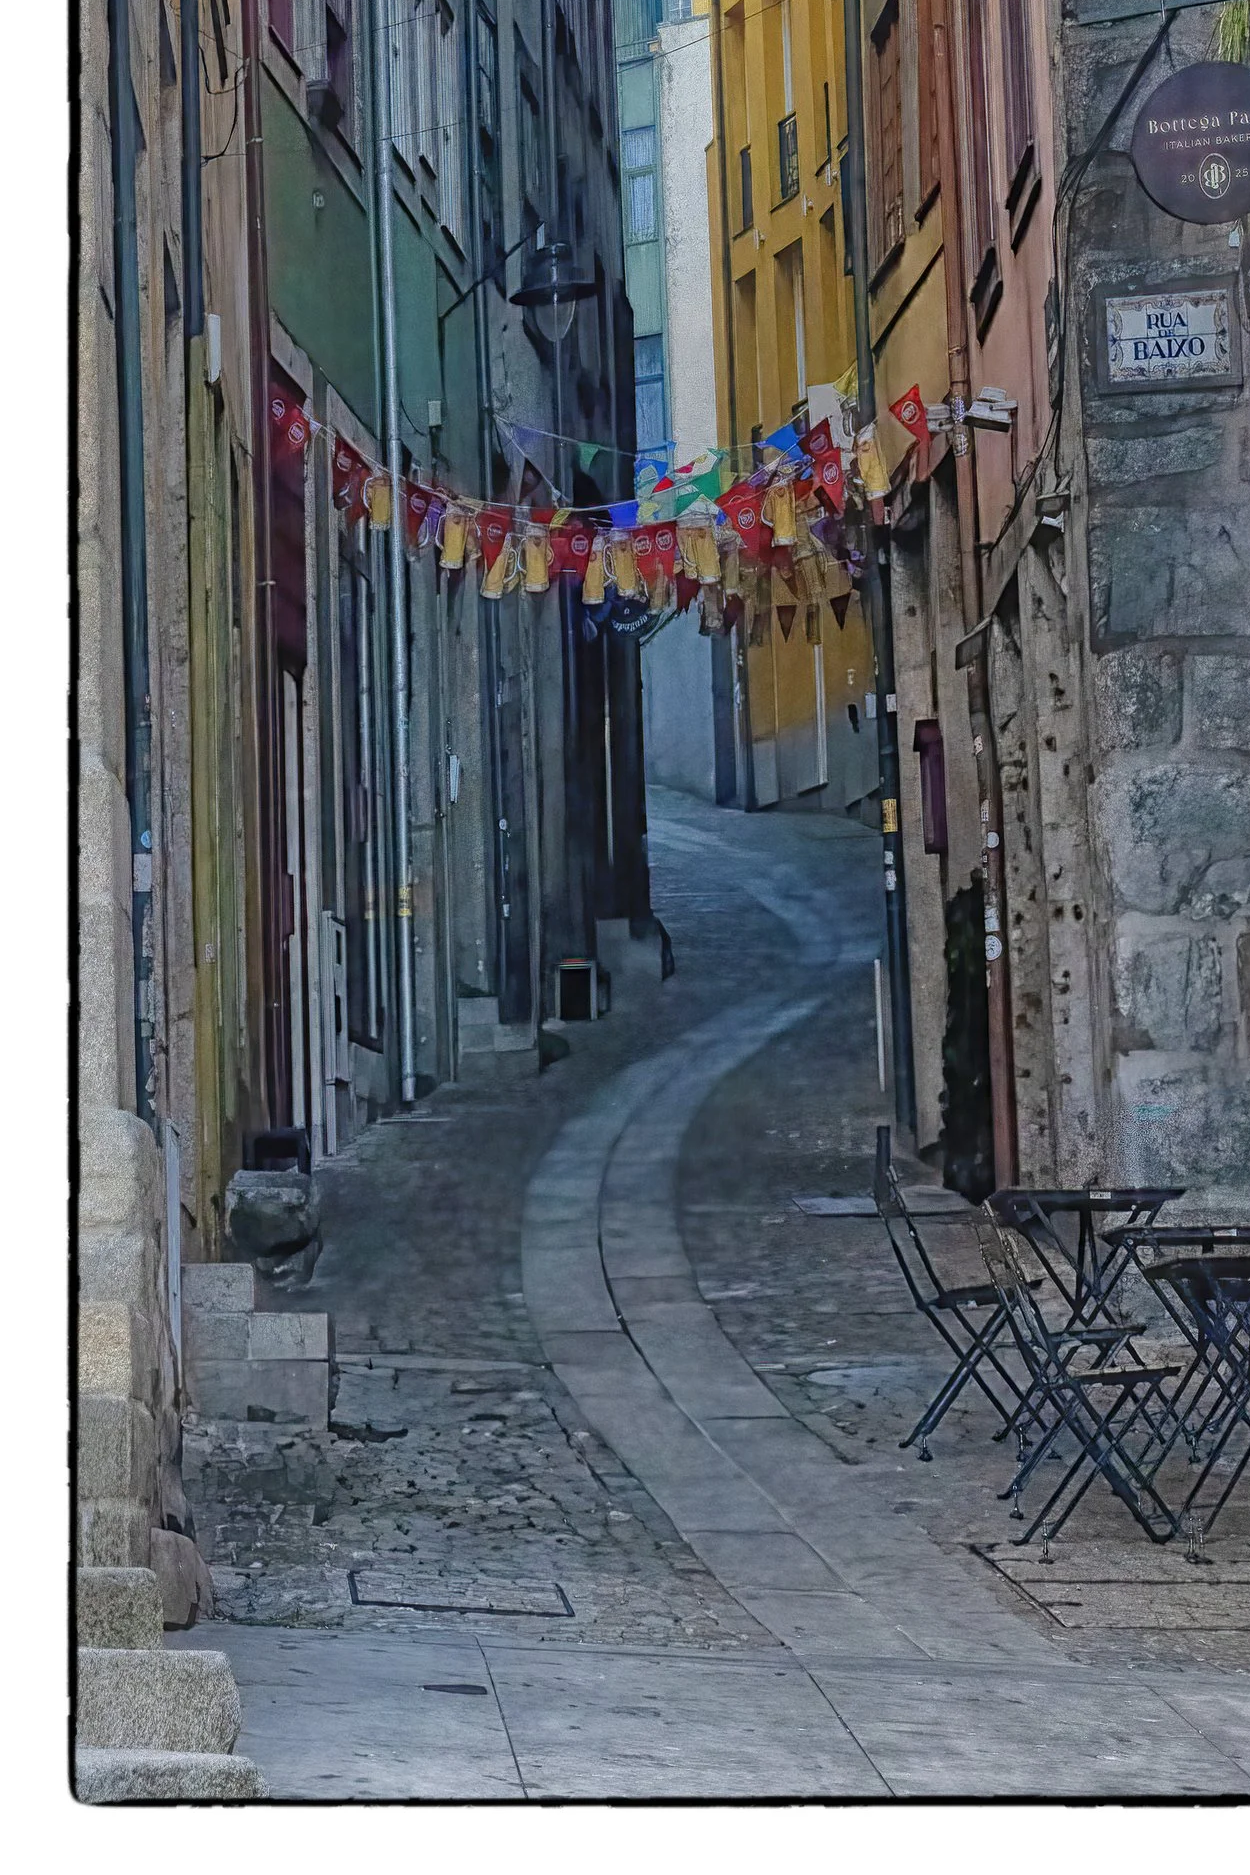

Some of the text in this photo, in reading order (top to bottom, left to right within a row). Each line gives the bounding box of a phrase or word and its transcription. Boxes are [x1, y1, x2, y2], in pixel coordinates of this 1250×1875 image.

[1148, 115, 1220, 134] Bottega
[1164, 137, 1211, 150] ITALIAN
[1181, 168, 1249, 183] 20 25
[1147, 312, 1188, 329] RUA
[1133, 337, 1205, 361] BAIXO
